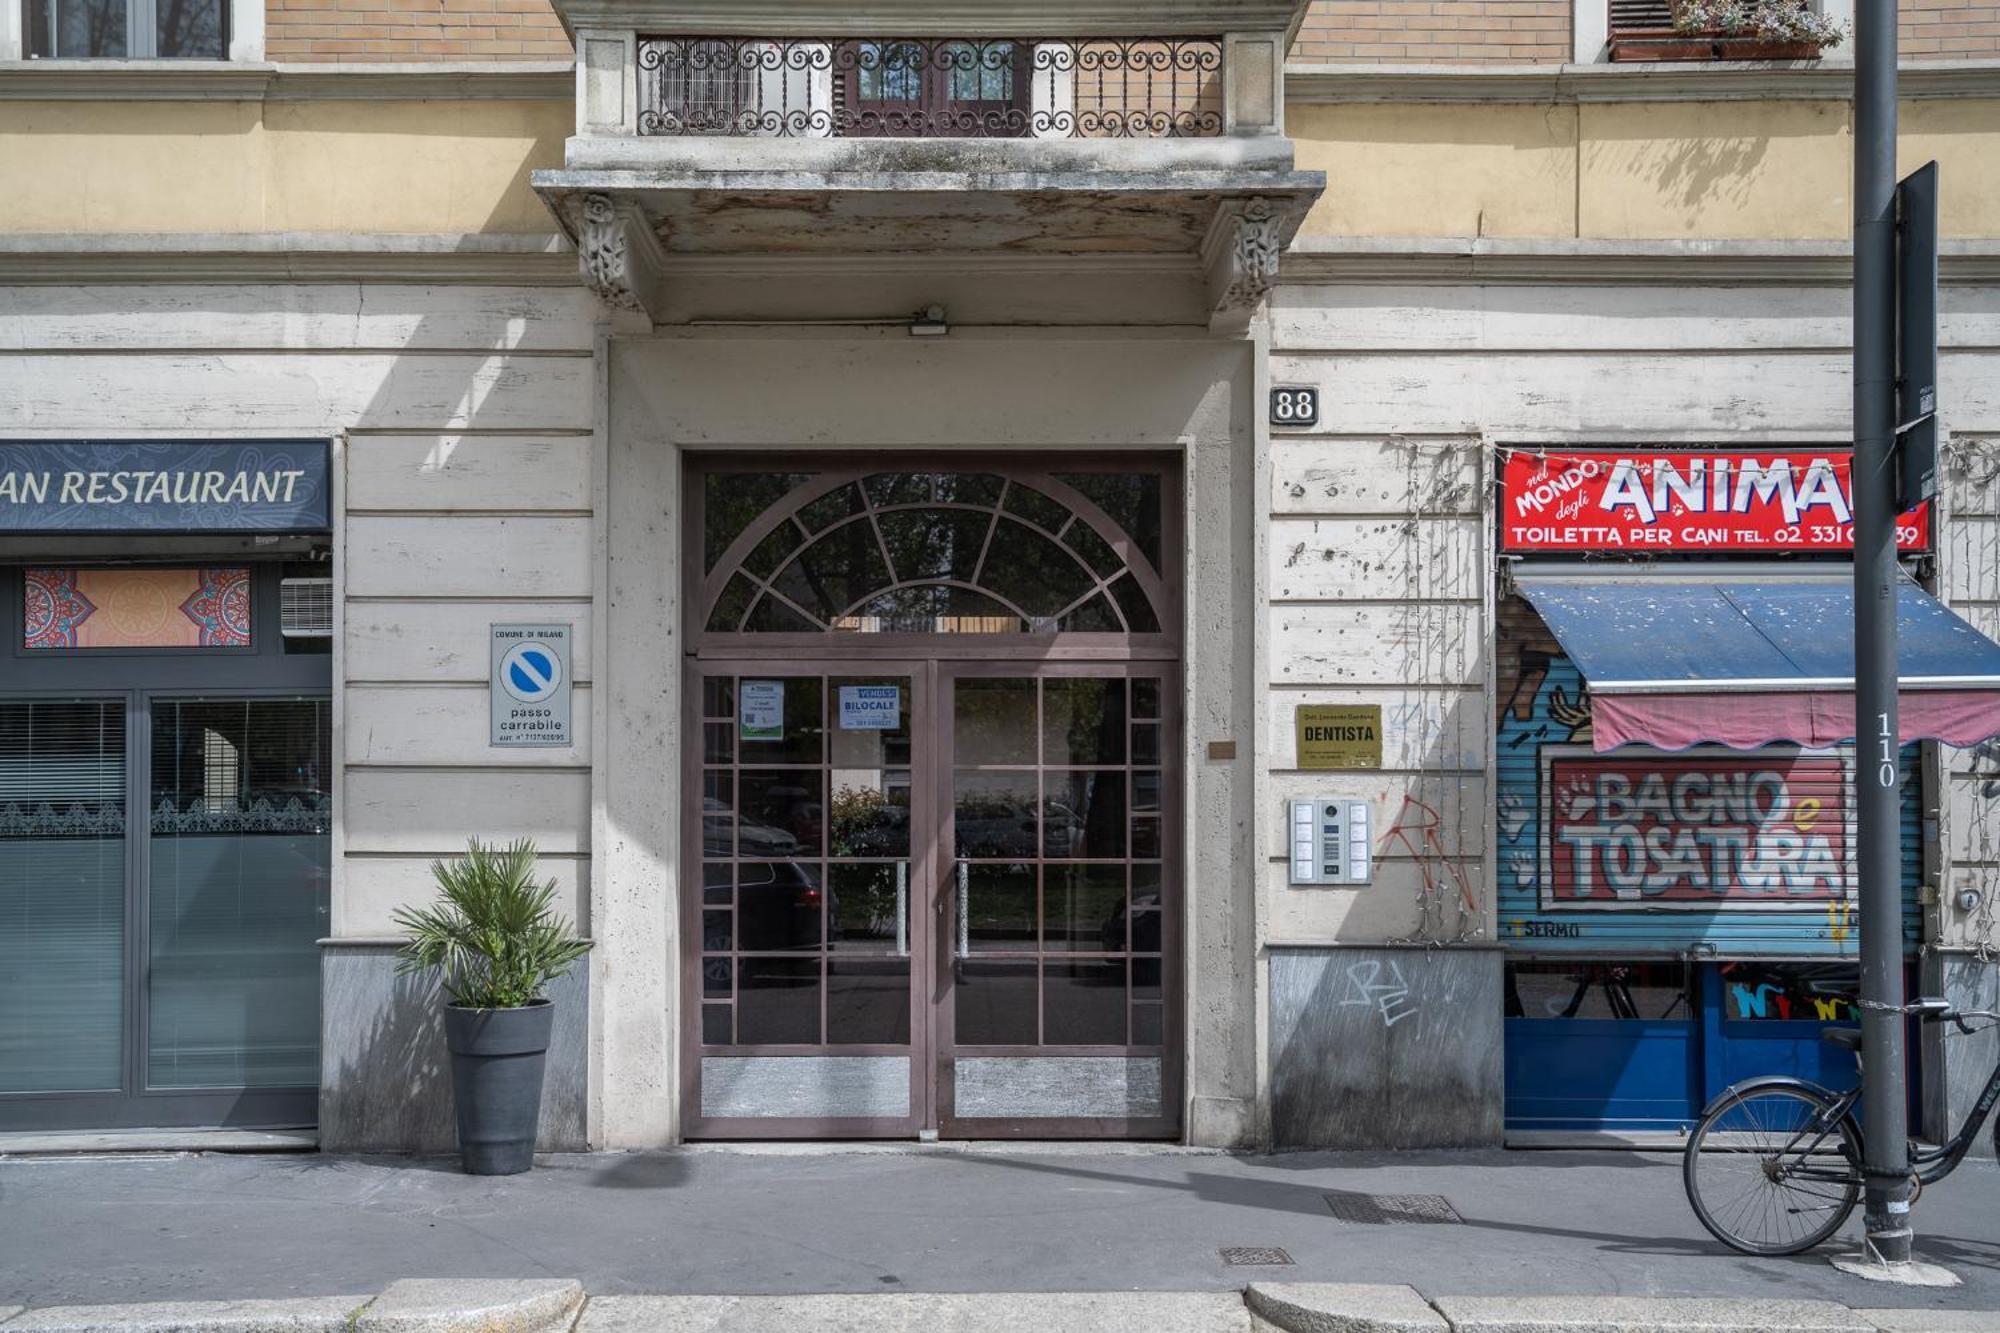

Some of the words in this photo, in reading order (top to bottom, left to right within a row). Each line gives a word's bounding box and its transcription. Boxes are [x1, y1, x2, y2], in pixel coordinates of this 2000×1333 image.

[1276, 392, 1313, 419] 88
[59, 470, 305, 504] RESTAURANT
[1527, 462, 1549, 488] nel
[1515, 459, 1599, 518] MONDO
[1555, 490, 1590, 520] degli
[1512, 527, 1623, 546] TOILETTA
[1630, 528, 1673, 545] PER
[1681, 528, 1728, 545] CANI
[1733, 530, 1770, 543] TEL.
[1774, 526, 1804, 543] 02
[495, 631, 523, 639] COMUNE
[527, 631, 535, 639] DI
[537, 631, 564, 639] MILANO
[511, 708, 552, 719] passo
[844, 701, 895, 710] BILOCALE
[500, 719, 562, 730] carrabile
[1304, 726, 1374, 741] DENTISTA
[1596, 771, 1791, 824] BAGNO
[1558, 824, 1844, 897] TOSATURA
